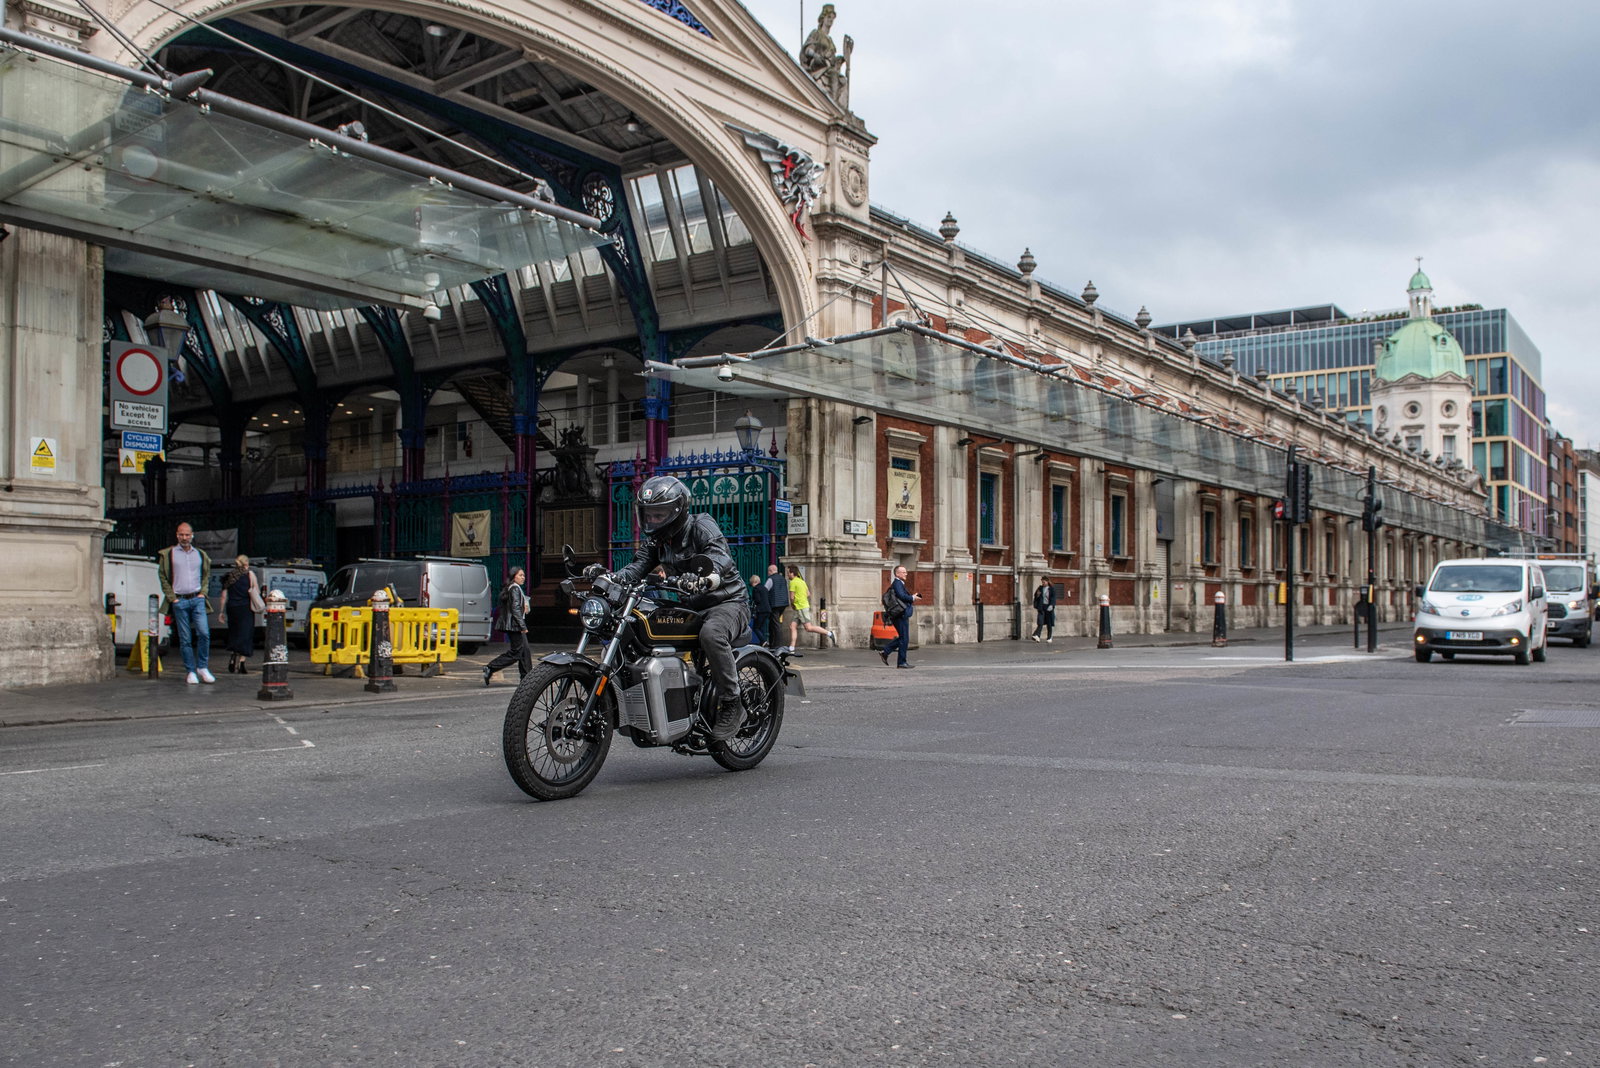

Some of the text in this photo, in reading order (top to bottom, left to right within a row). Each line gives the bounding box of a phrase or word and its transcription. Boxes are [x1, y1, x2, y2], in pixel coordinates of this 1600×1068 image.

[121, 410, 145, 418] Except
[127, 433, 157, 442] CYCLISTS
[125, 441, 159, 450] DISMOUNT
